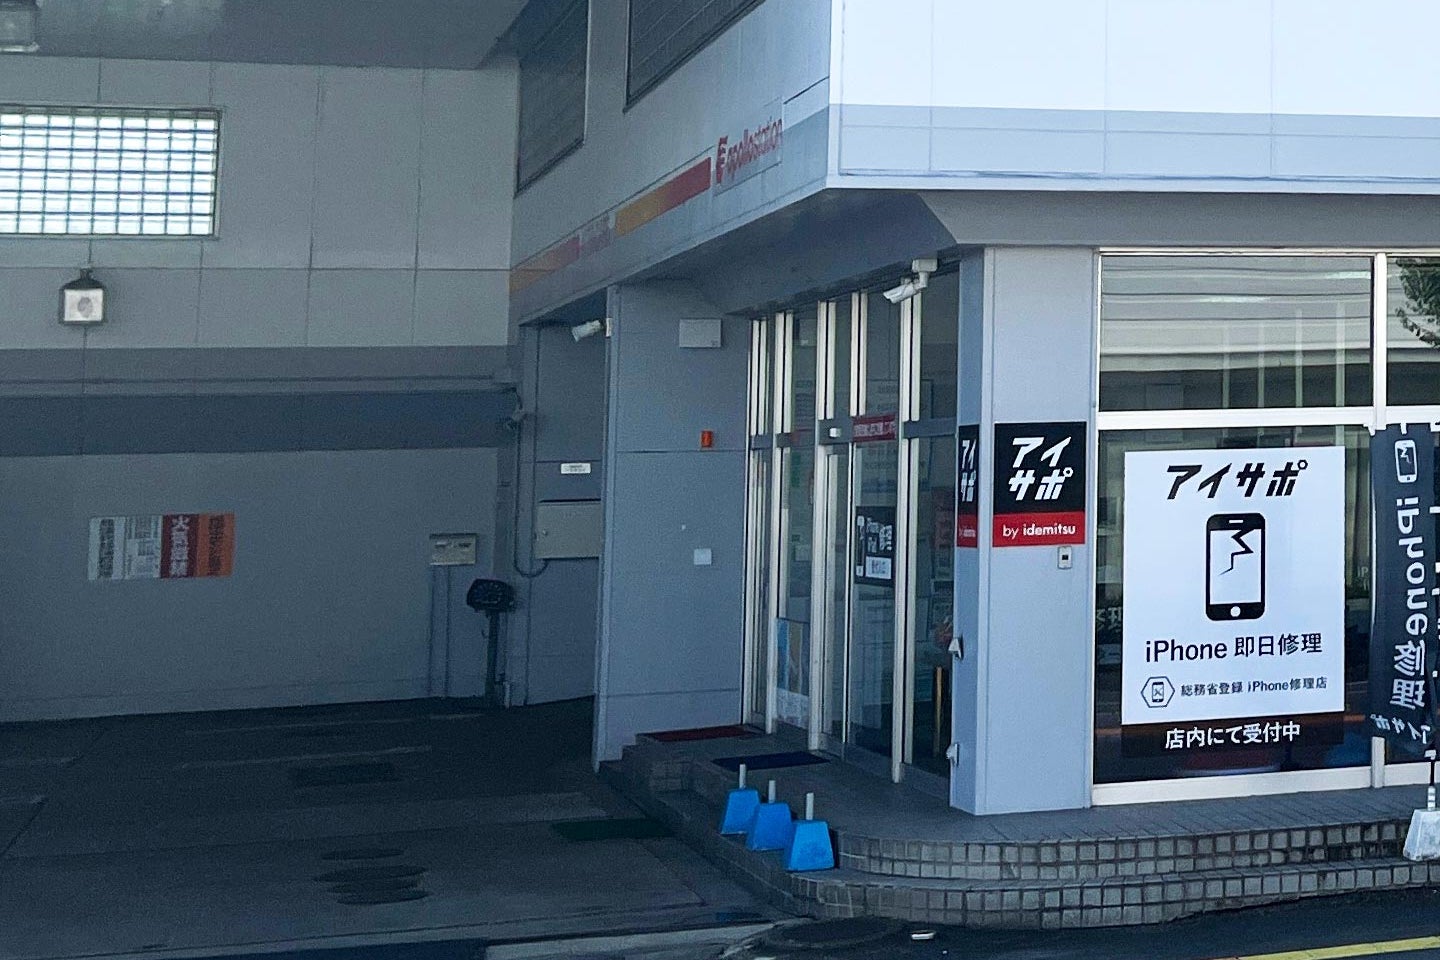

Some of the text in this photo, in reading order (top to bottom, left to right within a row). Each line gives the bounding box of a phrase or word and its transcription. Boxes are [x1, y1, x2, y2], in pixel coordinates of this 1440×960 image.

[1012, 436, 1072, 469] アイ
[1008, 467, 1074, 501] サポ
[1166, 459, 1308, 501] アイサポ
[1002, 523, 1076, 540] by idemitsu
[1146, 632, 1323, 663] iPhone 即日修理
[1180, 681, 1243, 697] 総務省登録
[1165, 720, 1302, 750] 店内にて受付中
